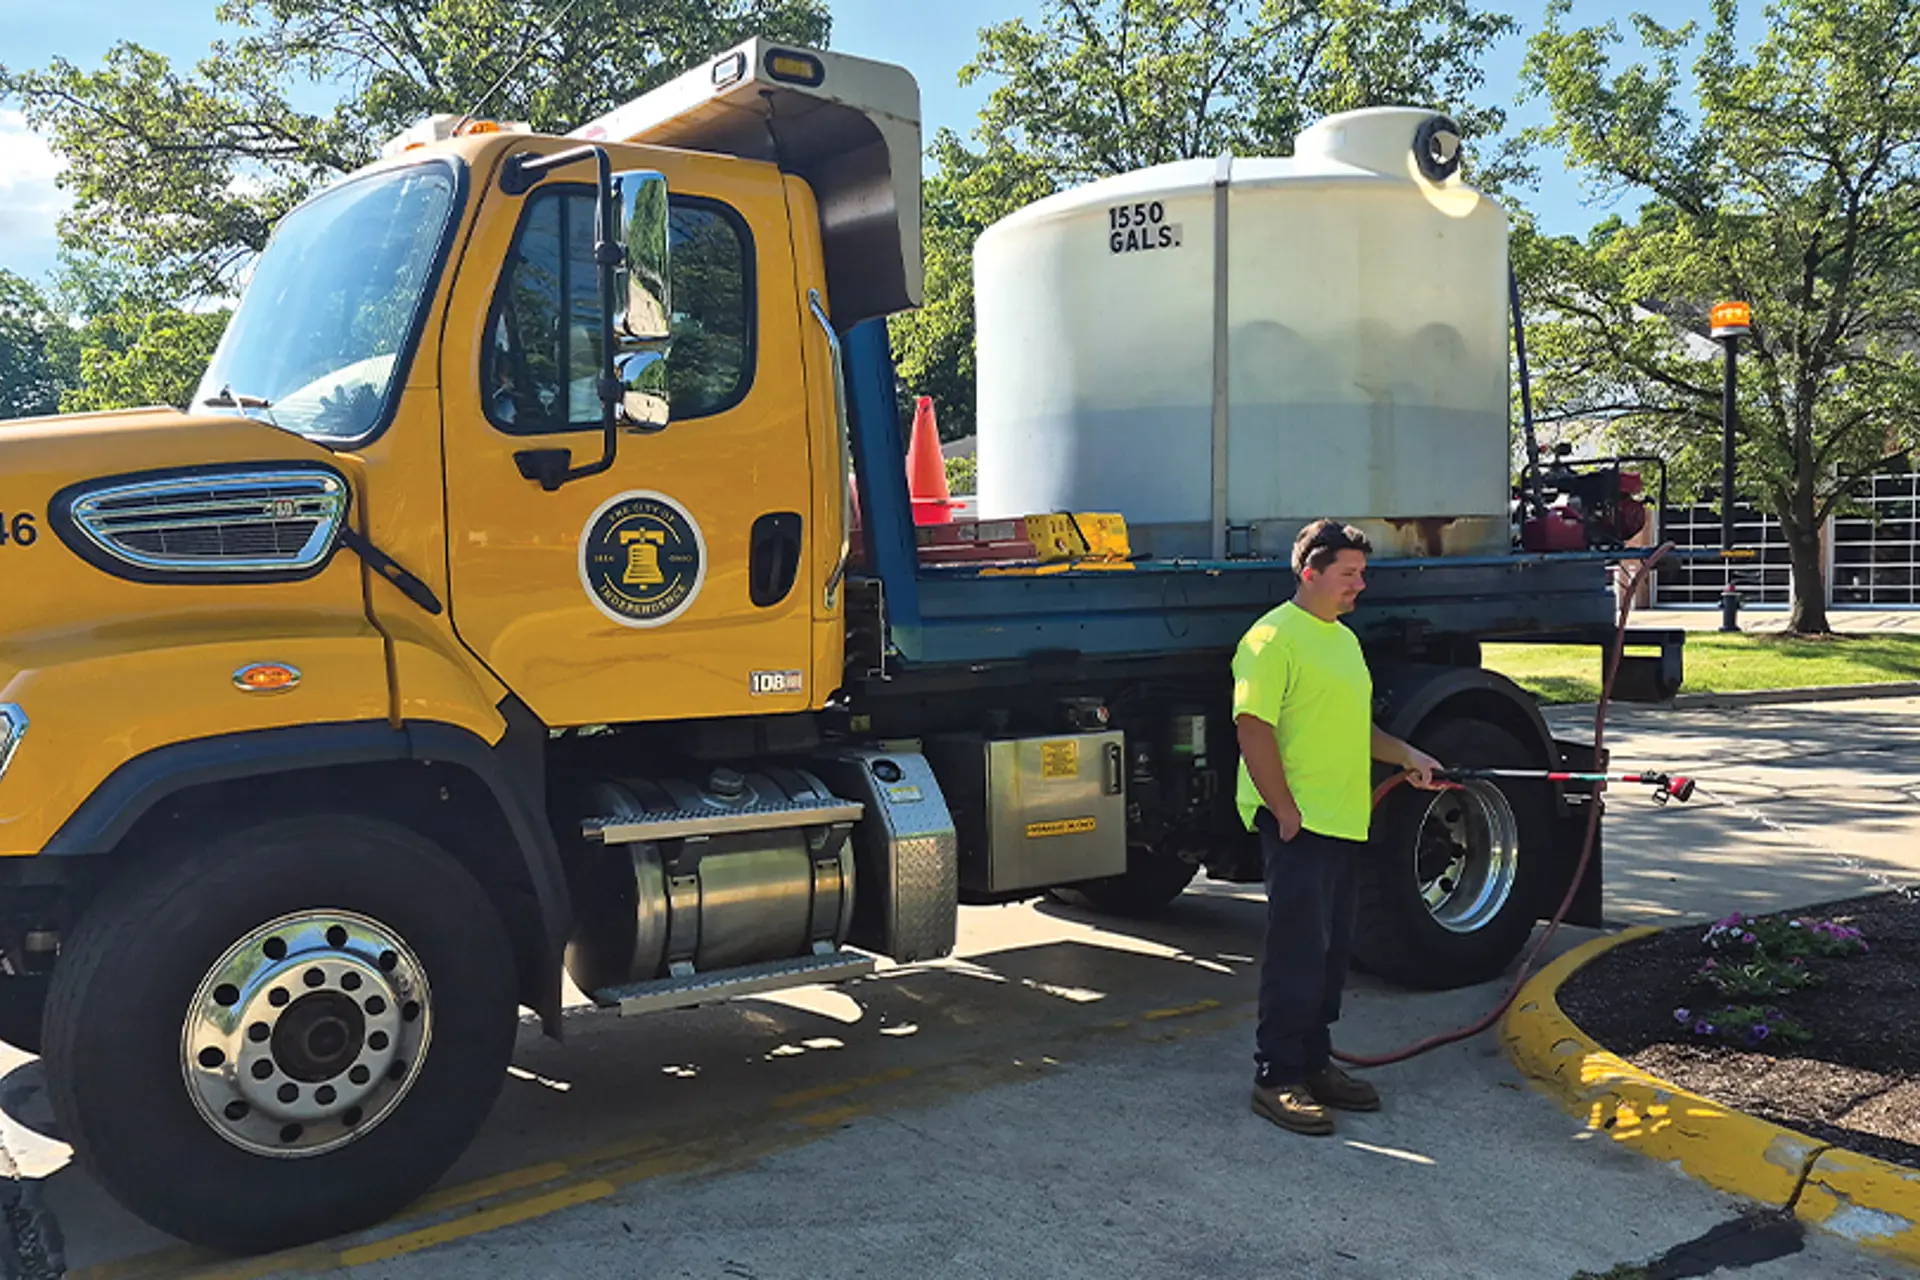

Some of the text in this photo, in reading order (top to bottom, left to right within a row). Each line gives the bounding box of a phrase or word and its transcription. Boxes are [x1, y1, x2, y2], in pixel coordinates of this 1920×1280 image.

[1109, 201, 1164, 230] 1550
[1110, 225, 1180, 253] GALS.
[632, 503, 660, 513] CITY
[599, 584, 686, 614] INDEPENDENCE
